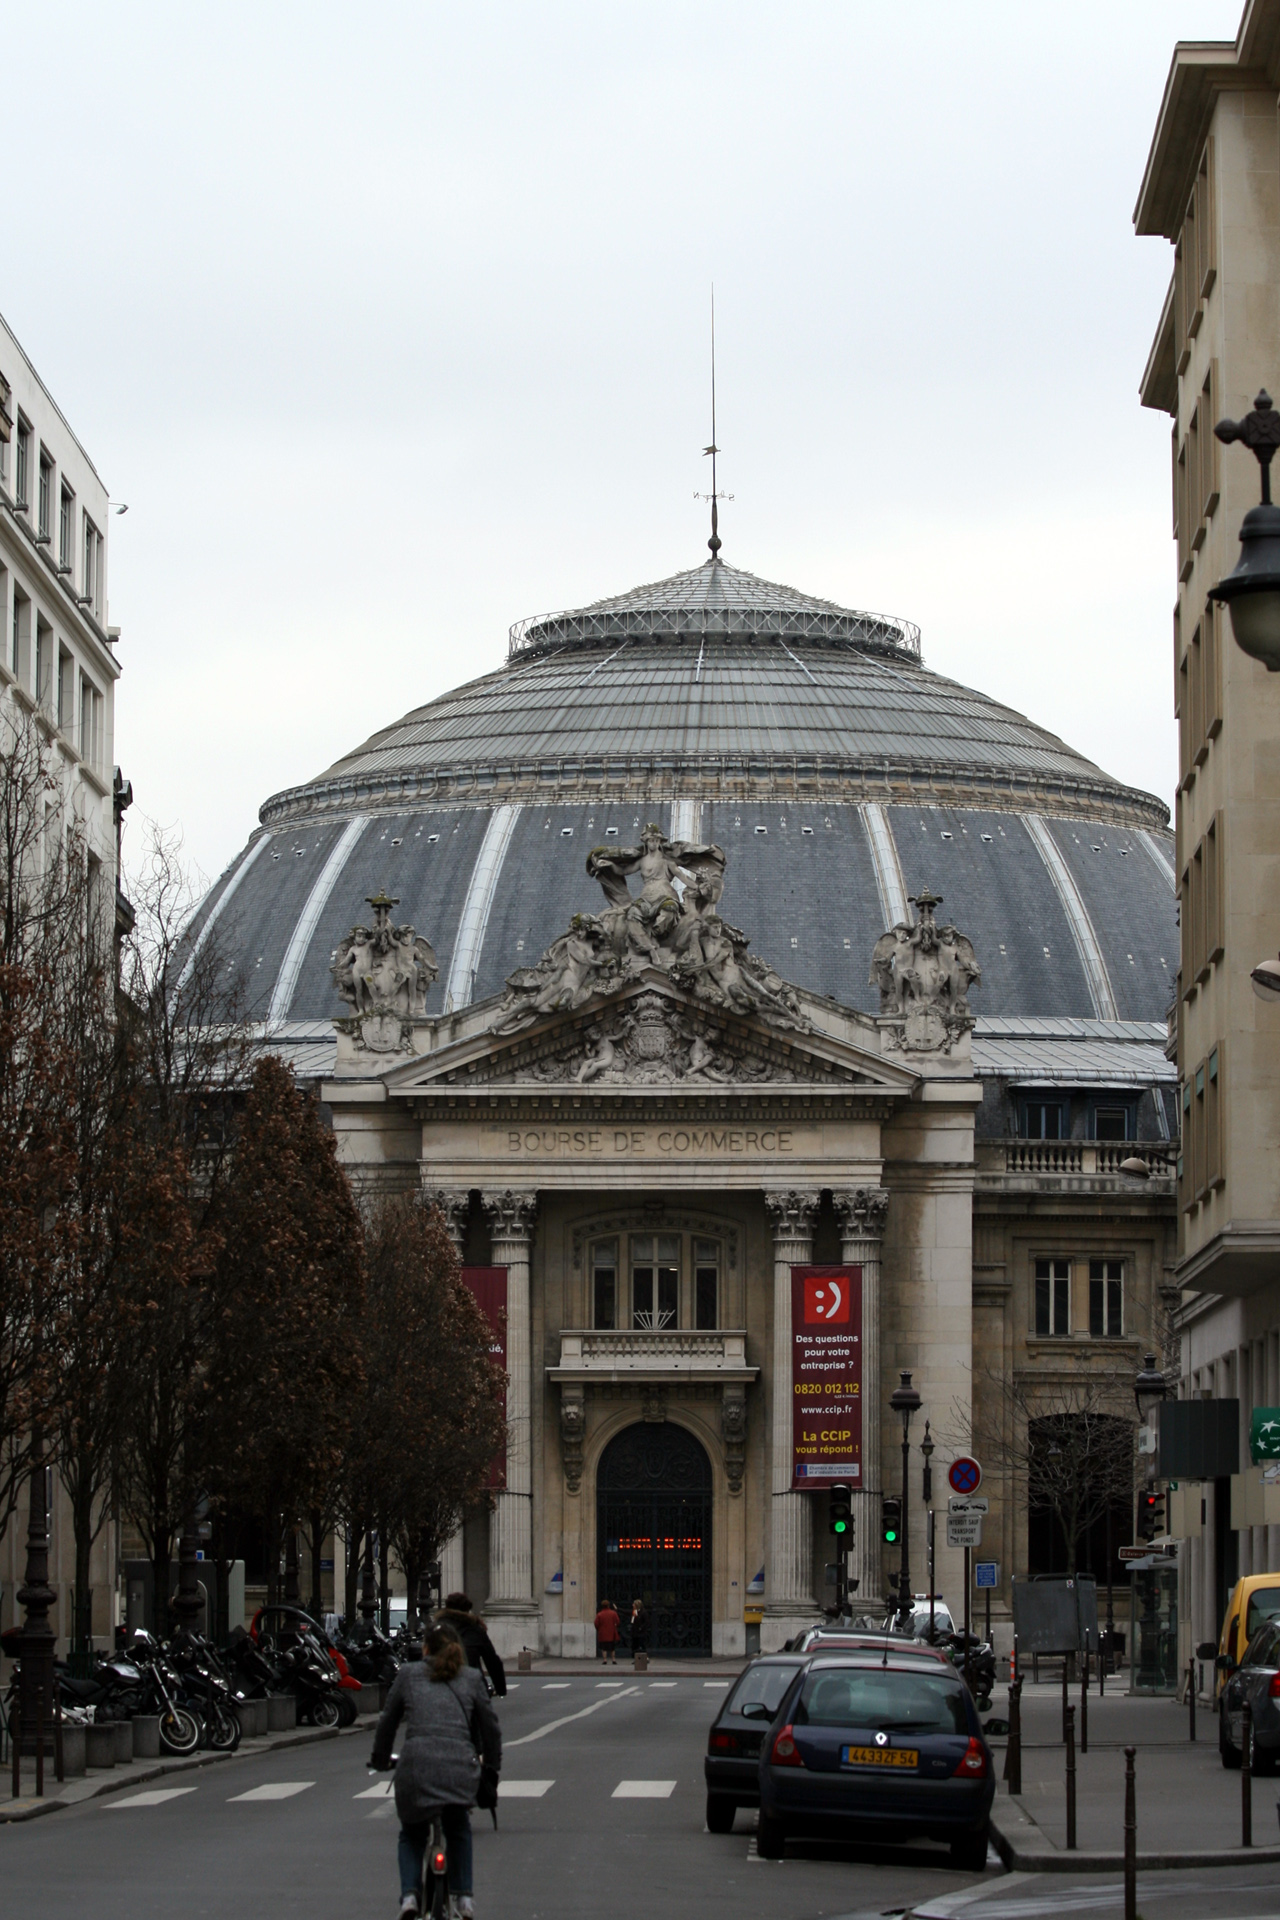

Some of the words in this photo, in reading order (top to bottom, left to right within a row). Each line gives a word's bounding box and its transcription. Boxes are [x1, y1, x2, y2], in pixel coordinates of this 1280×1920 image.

[508, 1131, 602, 1152] BOURSE
[614, 1131, 646, 1152] DE
[657, 1131, 794, 1152] COMMERCE
[796, 1335, 813, 1343] Des
[815, 1335, 859, 1344] questions
[804, 1349, 826, 1358] pour
[827, 1348, 850, 1356] votre
[800, 1361, 846, 1371] entreprise
[848, 1361, 854, 1369] ?
[794, 1383, 822, 1394] 0820
[824, 1383, 842, 1394] 012
[844, 1383, 859, 1394] 112
[801, 1405, 852, 1415] www.ccip.fr
[802, 1431, 817, 1441] La
[820, 1430, 851, 1441] CCIP
[795, 1446, 818, 1454] vous
[820, 1445, 853, 1455] répond
[900, 1753, 914, 1765] 54
